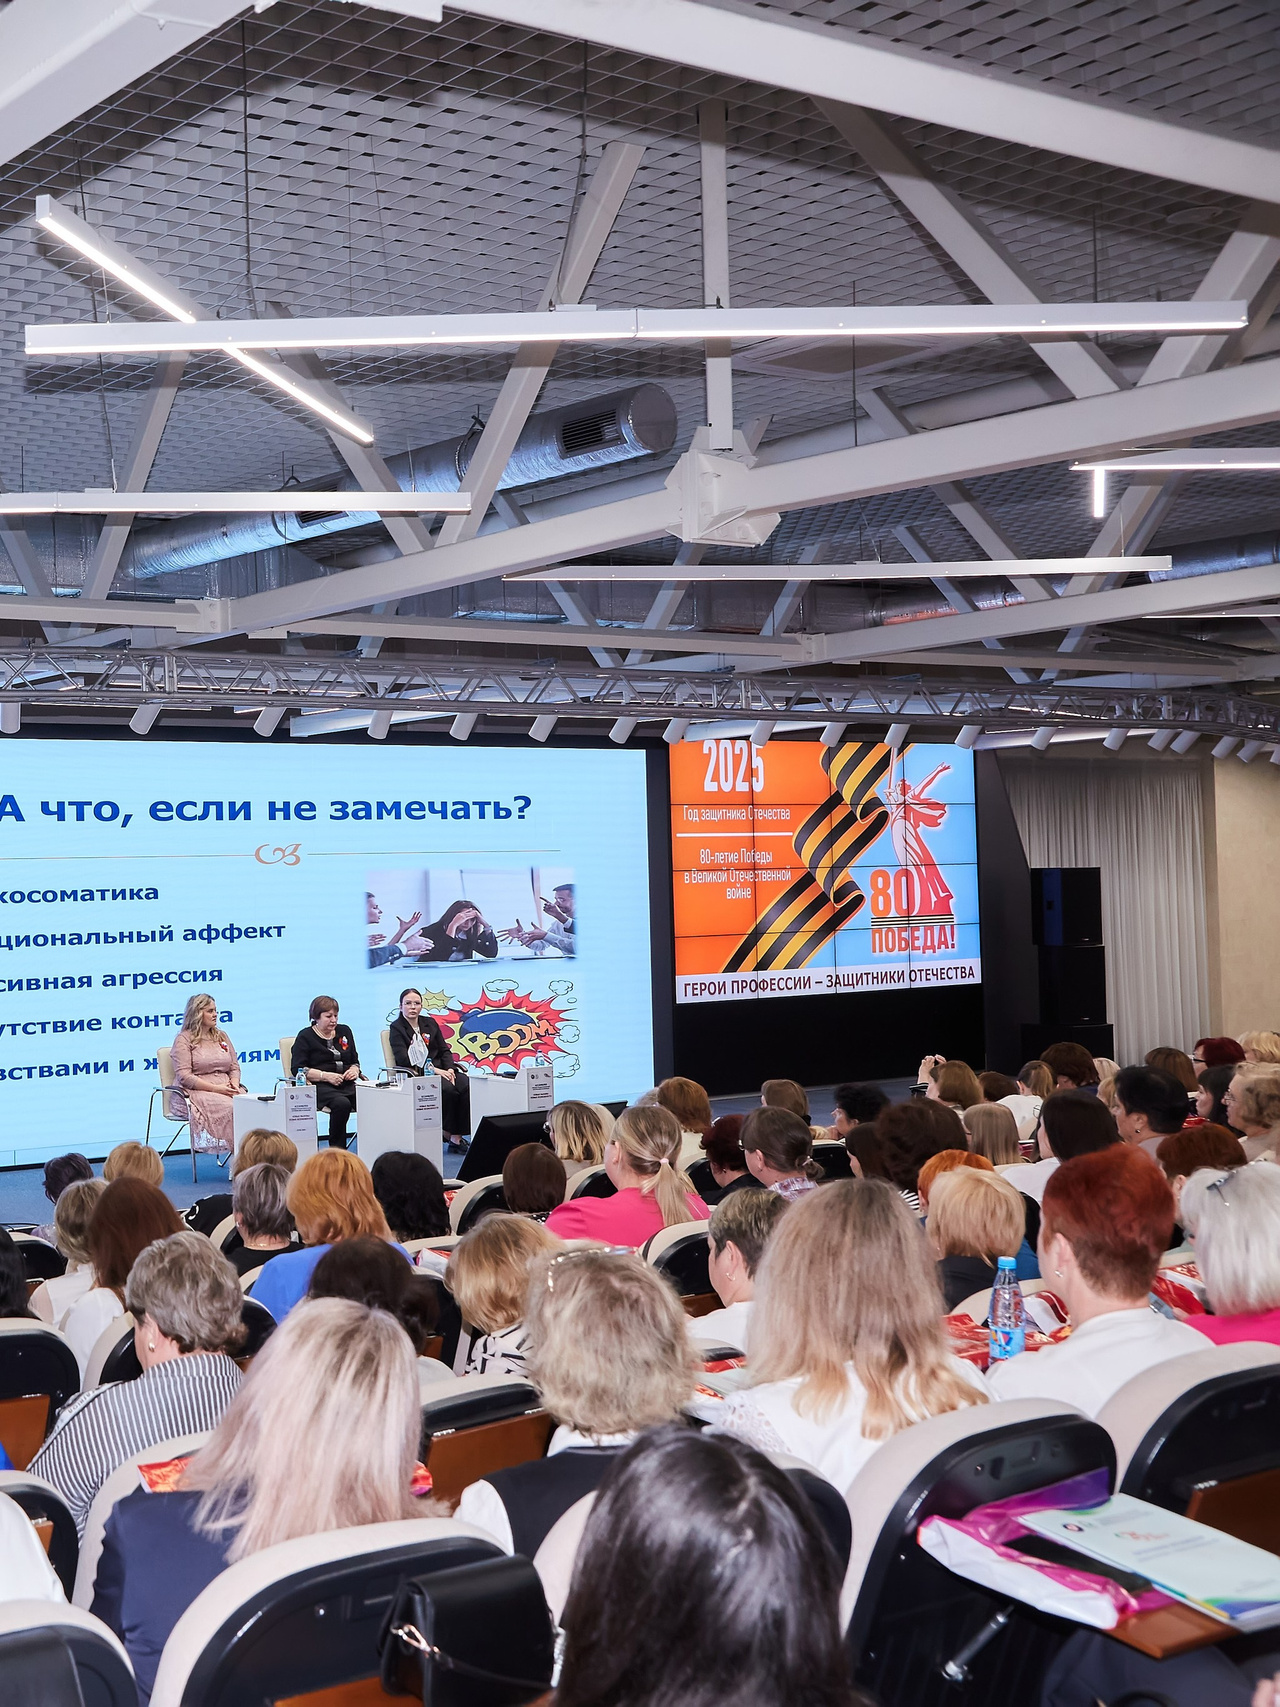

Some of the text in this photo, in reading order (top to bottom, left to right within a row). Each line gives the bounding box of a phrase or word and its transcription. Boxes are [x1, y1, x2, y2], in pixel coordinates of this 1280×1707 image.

[702, 739, 765, 793] 2025
[40, 800, 133, 828] что,
[148, 800, 252, 822] если
[268, 799, 317, 821] не
[329, 795, 532, 821] замечать?
[683, 805, 791, 823] Год защитника Отечества
[700, 848, 773, 865] 80-летие Победы
[684, 865, 792, 884] в Великой Отечественной
[726, 884, 752, 899] войне
[870, 868, 916, 917] 80
[182, 922, 286, 944] аффект
[871, 925, 956, 954] ПОБЕДА!
[101, 968, 223, 989] агрессия
[684, 979, 727, 998] ГЕРОИ
[731, 974, 812, 994] ПРОФЕССИИ
[826, 969, 905, 989] ЗАЩИТНИКИ
[909, 965, 976, 983] ОТЕЧЕСТВА
[457, 1019, 558, 1061] BOOM
[119, 1059, 135, 1072] и
